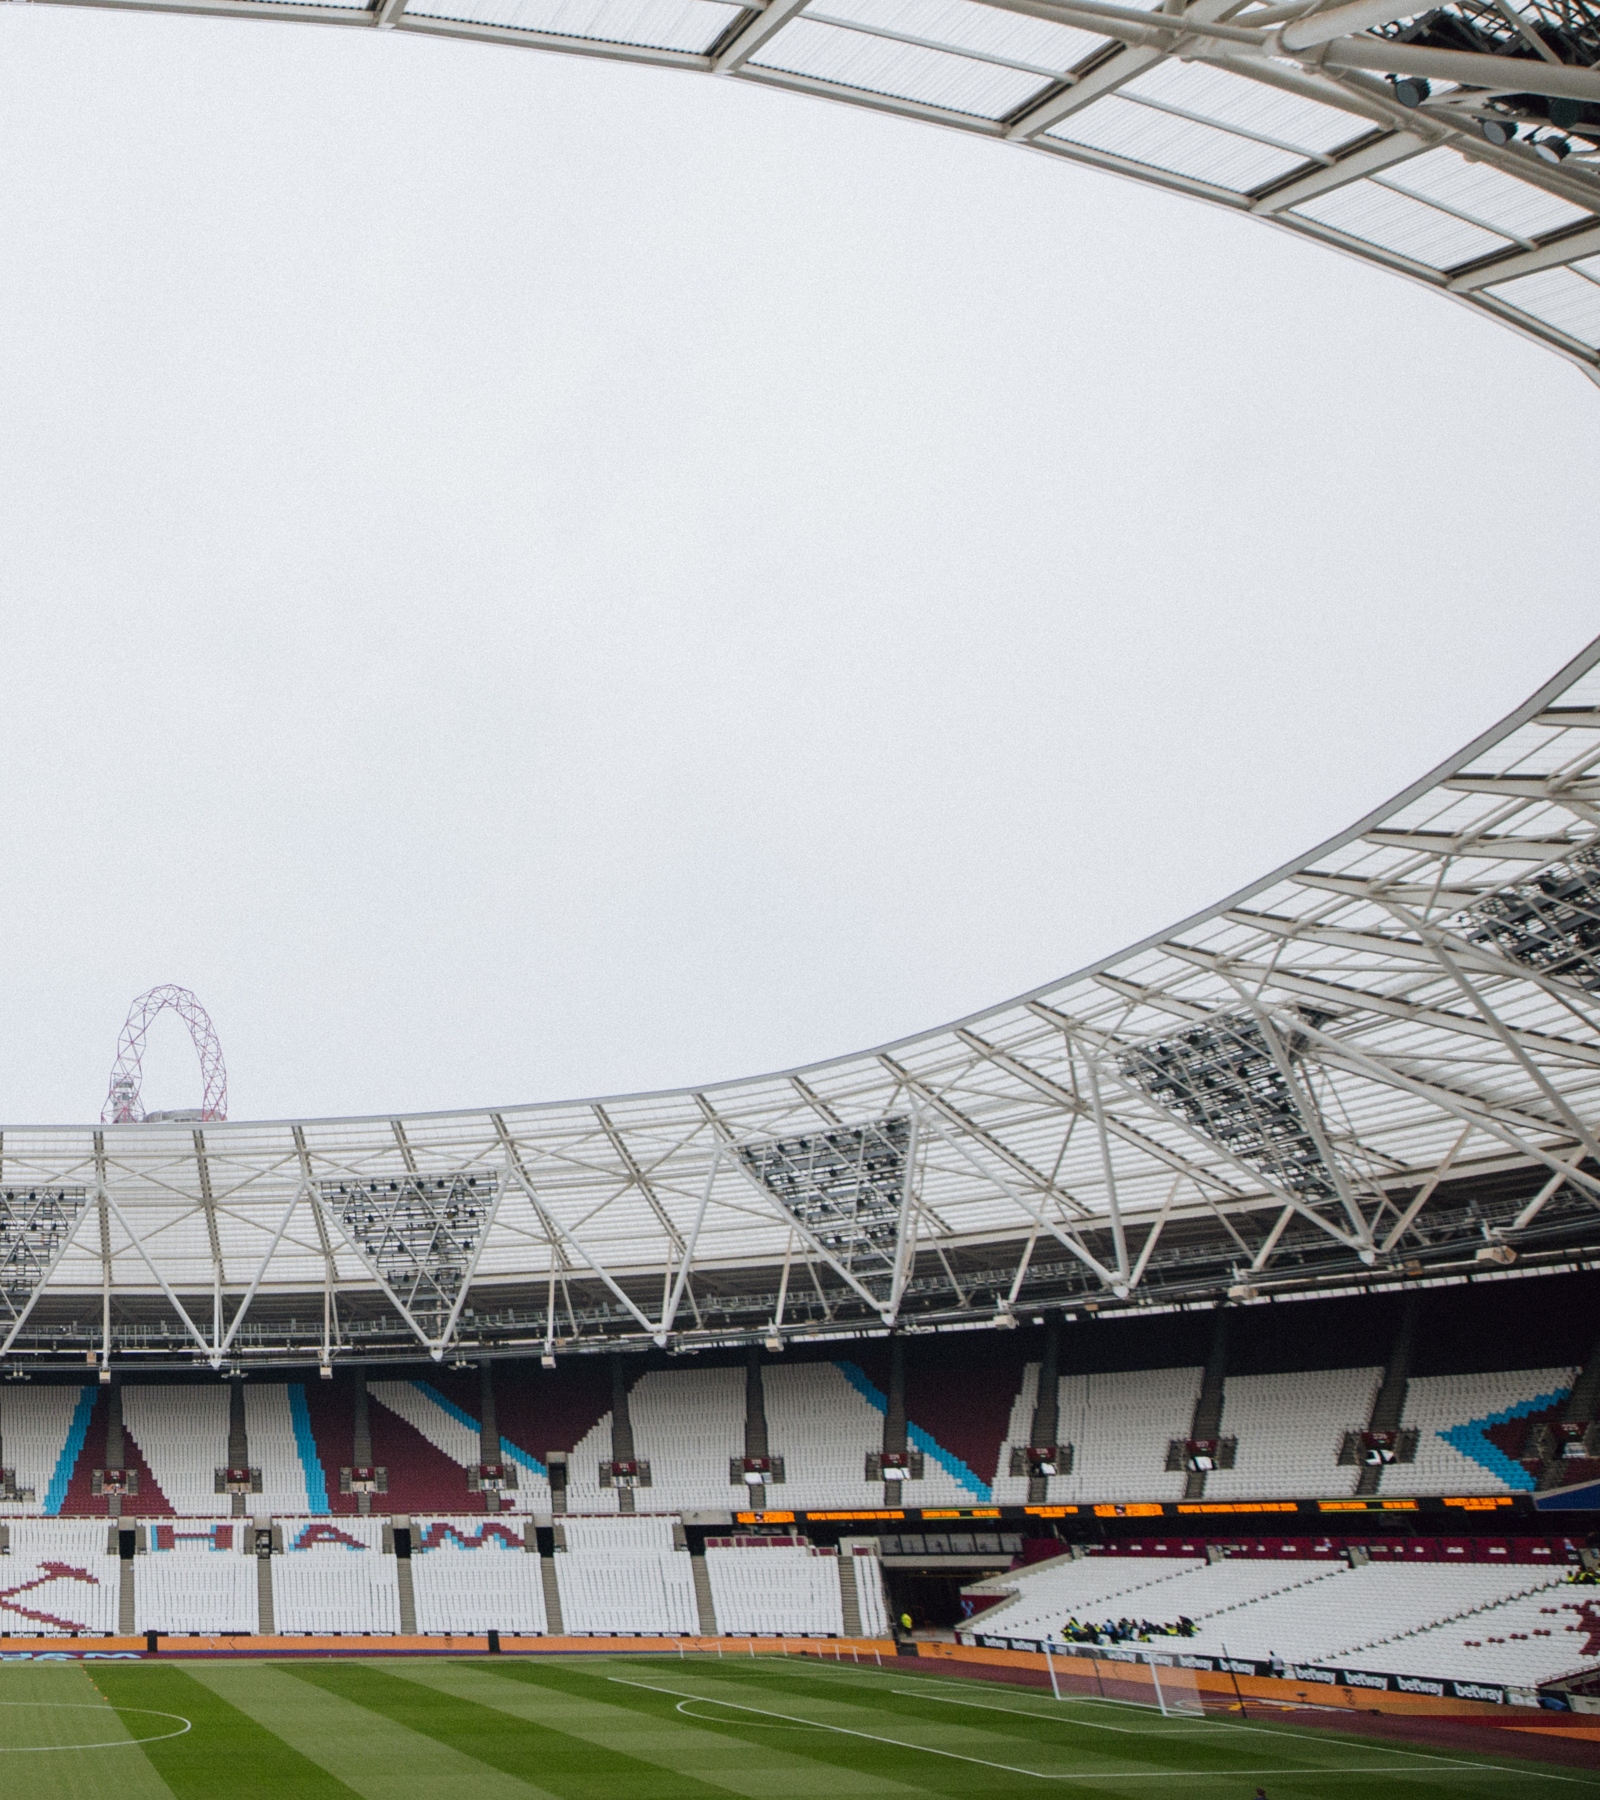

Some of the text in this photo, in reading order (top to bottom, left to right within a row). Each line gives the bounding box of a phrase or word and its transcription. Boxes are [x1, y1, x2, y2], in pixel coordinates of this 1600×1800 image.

[1295, 1665, 1336, 1685] betway
[1344, 1670, 1388, 1690] betway
[1396, 1676, 1444, 1697] betway
[1453, 1681, 1504, 1704] betway
